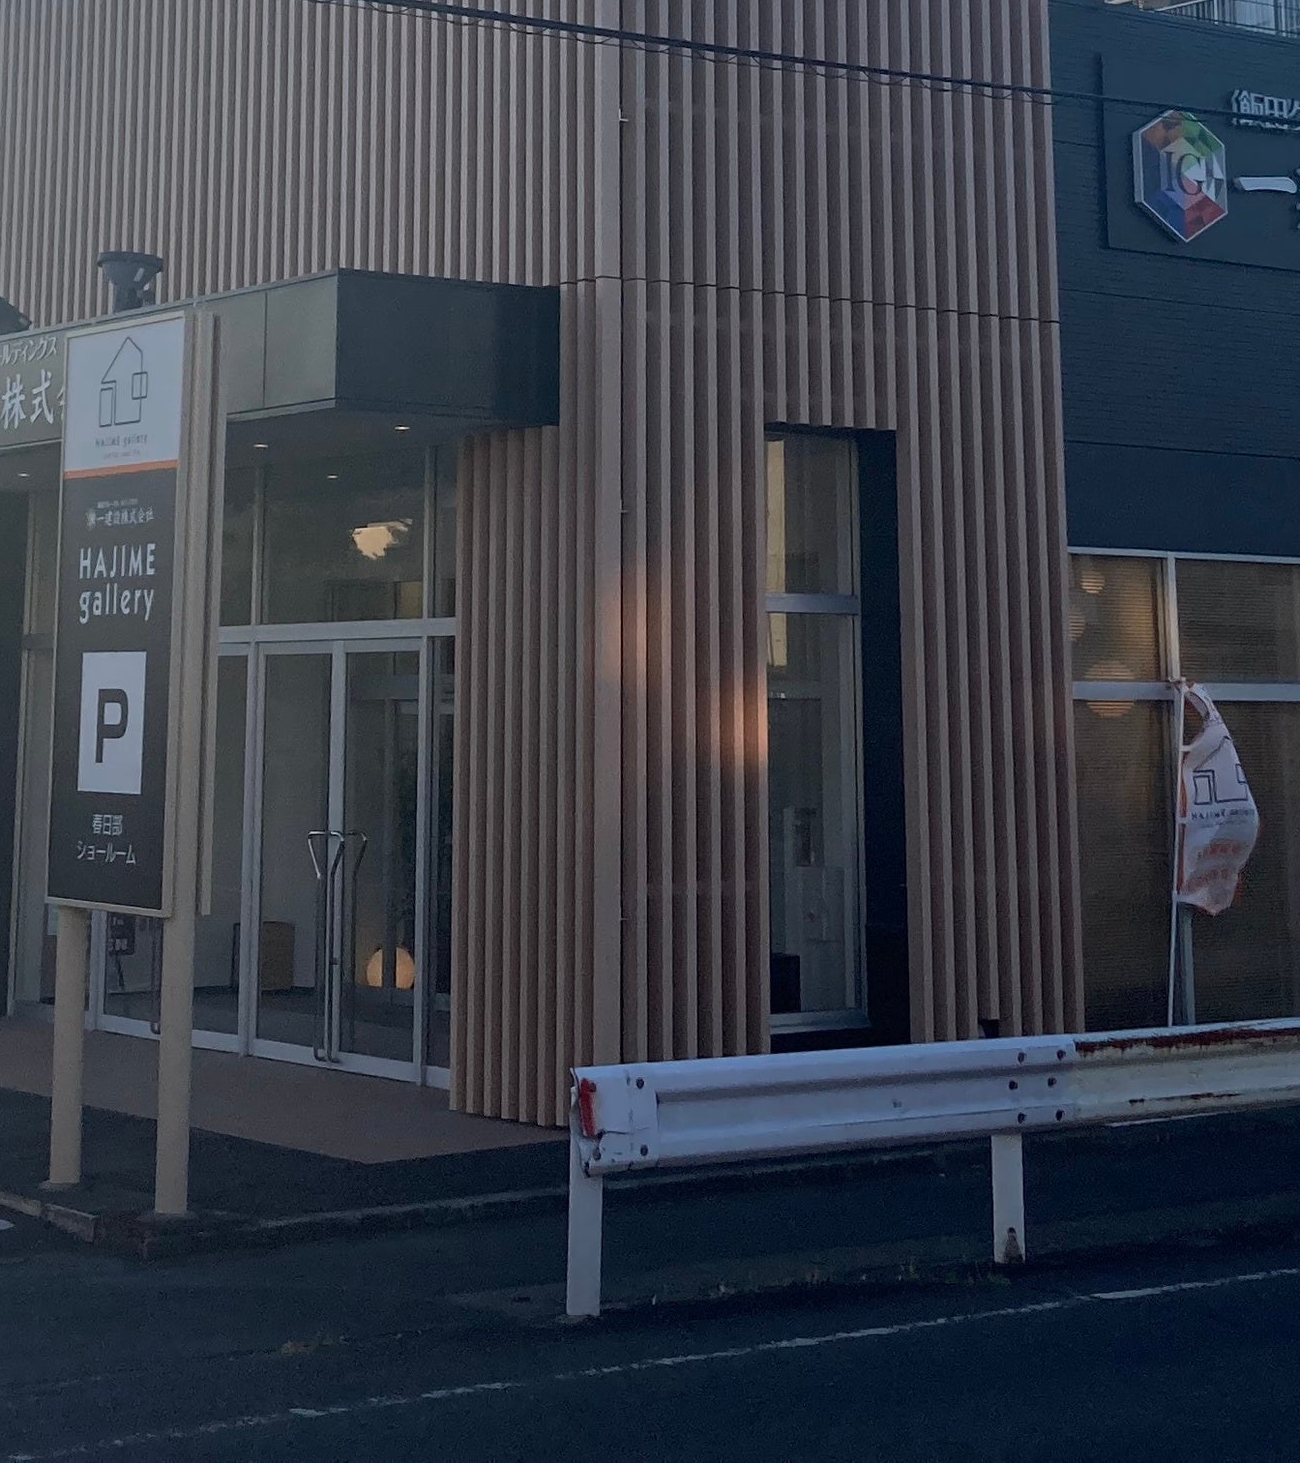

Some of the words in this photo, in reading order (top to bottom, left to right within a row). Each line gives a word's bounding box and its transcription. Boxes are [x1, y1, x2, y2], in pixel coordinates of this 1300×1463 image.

[79, 542, 156, 580] HAJIME
[78, 586, 156, 625] gallery
[95, 688, 129, 764] P
[92, 814, 124, 836] 春日部
[76, 840, 137, 865] ショールーム
